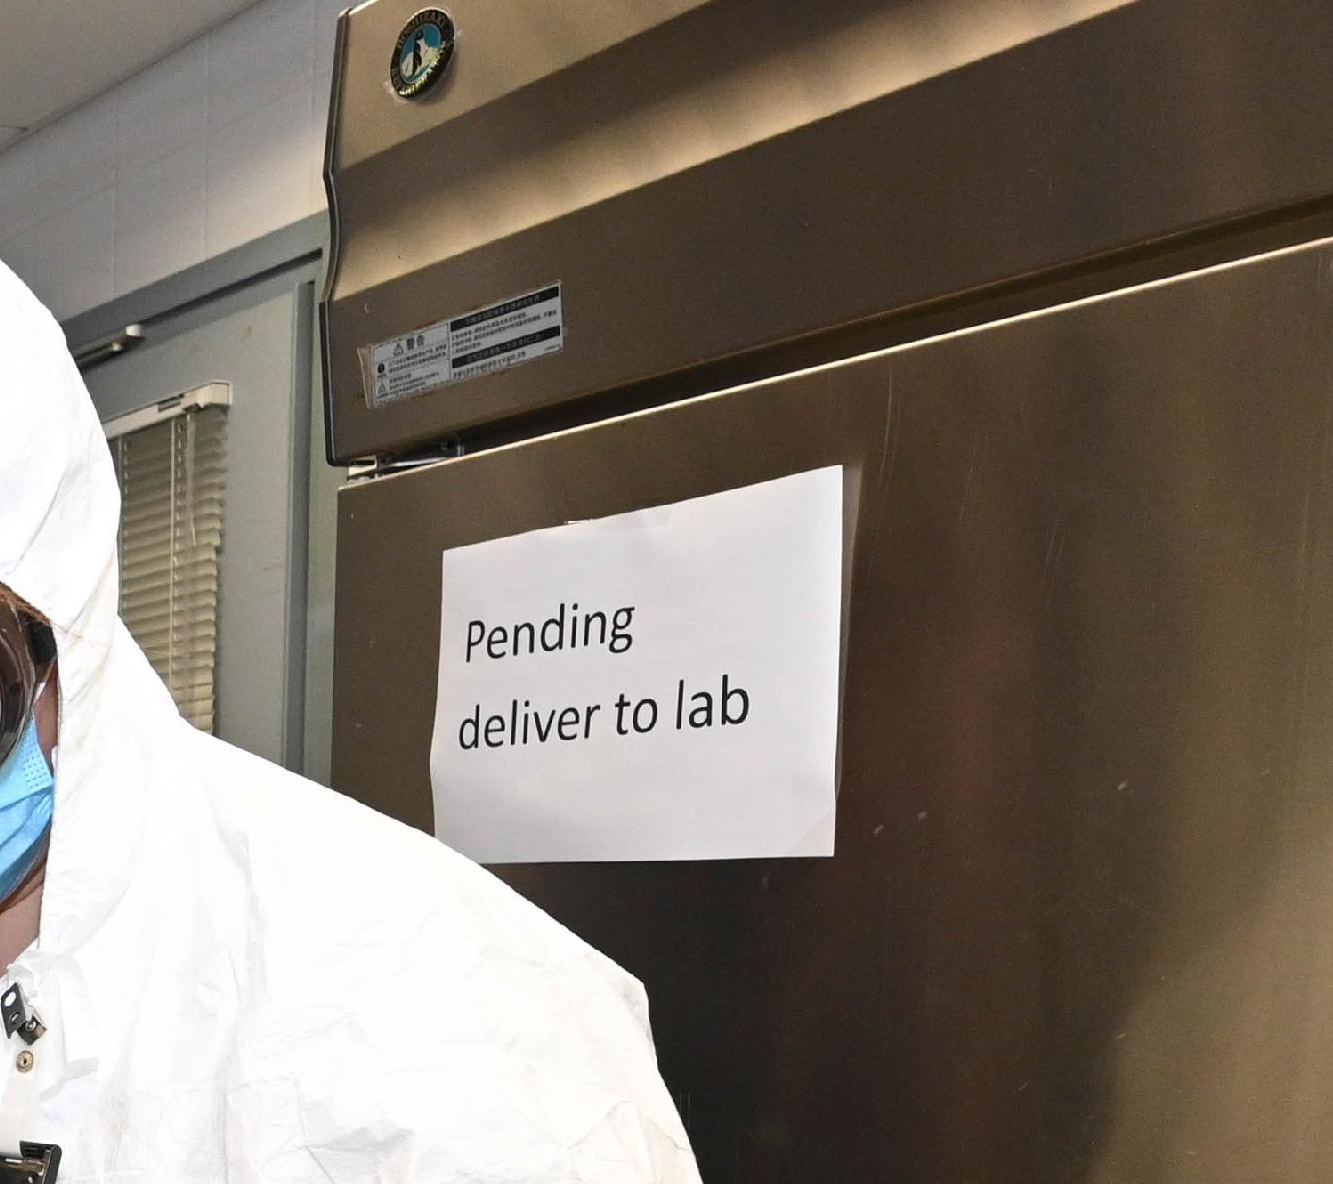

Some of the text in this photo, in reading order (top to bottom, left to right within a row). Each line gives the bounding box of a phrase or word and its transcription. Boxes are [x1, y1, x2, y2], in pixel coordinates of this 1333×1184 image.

[465, 603, 636, 663] Pending
[459, 674, 751, 751] deliver to lab
